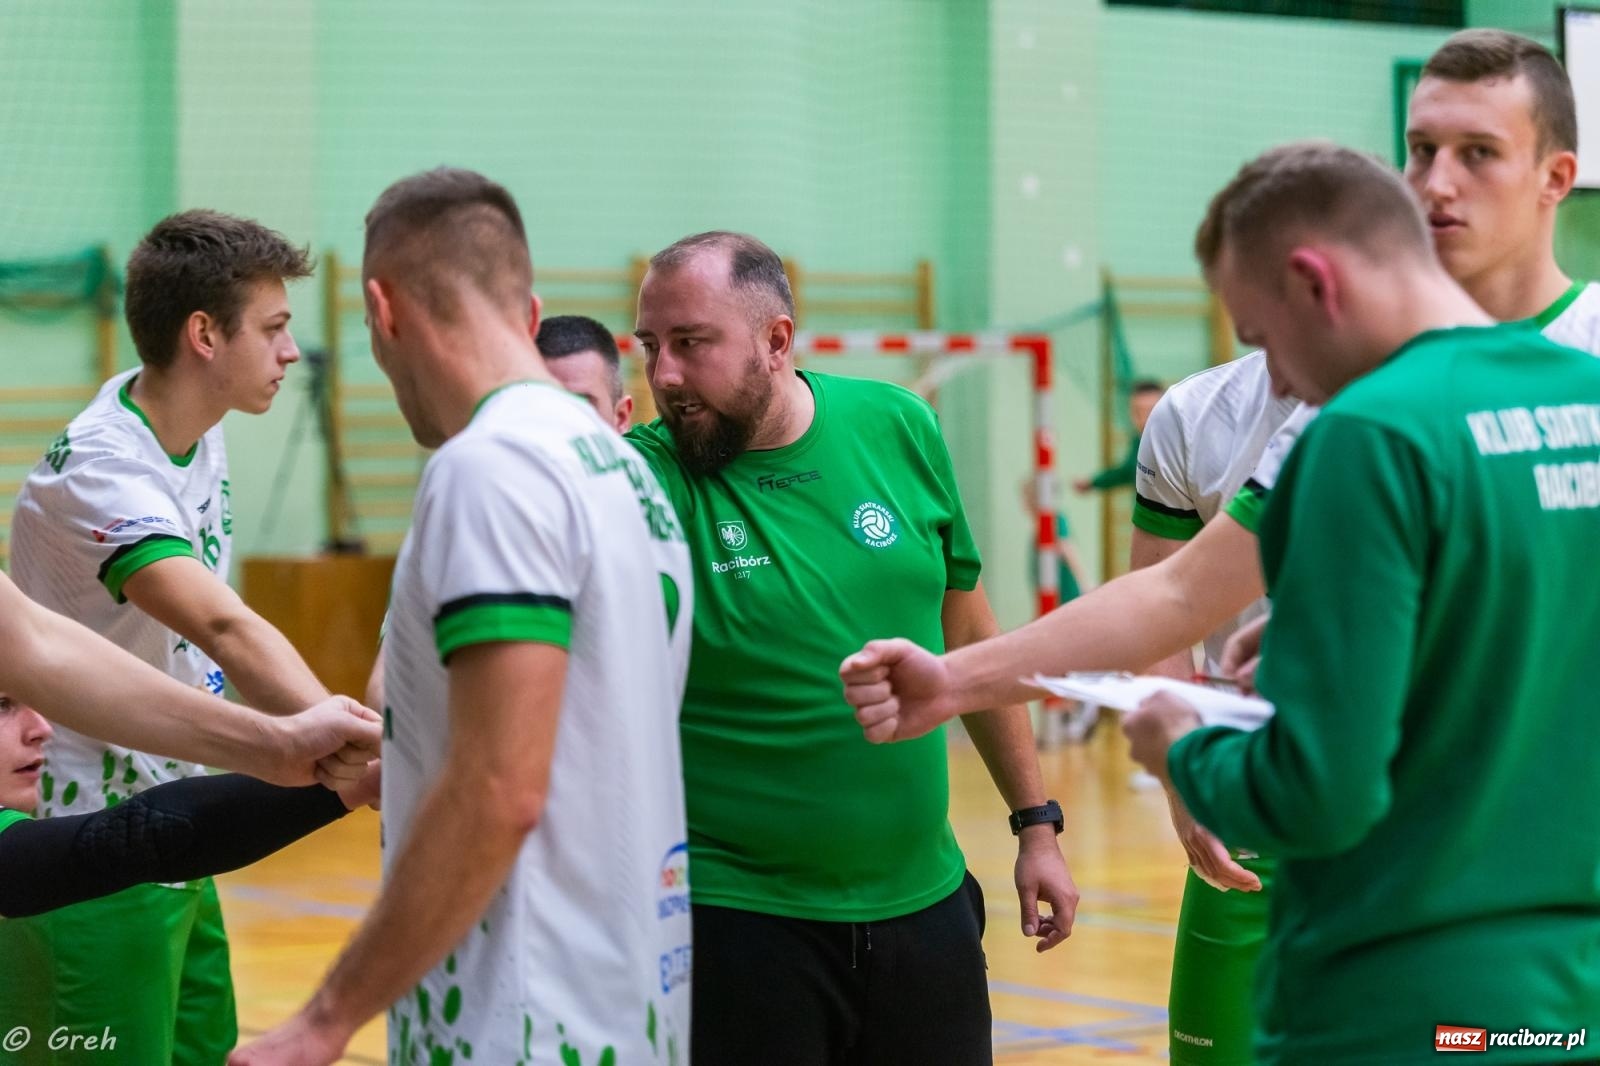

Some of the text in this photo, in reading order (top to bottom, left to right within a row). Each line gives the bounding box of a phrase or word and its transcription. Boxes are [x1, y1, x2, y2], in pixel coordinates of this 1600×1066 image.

[1465, 406, 1542, 456] KLUB
[712, 555, 771, 573] Racibórz
[734, 570, 751, 580] 1217
